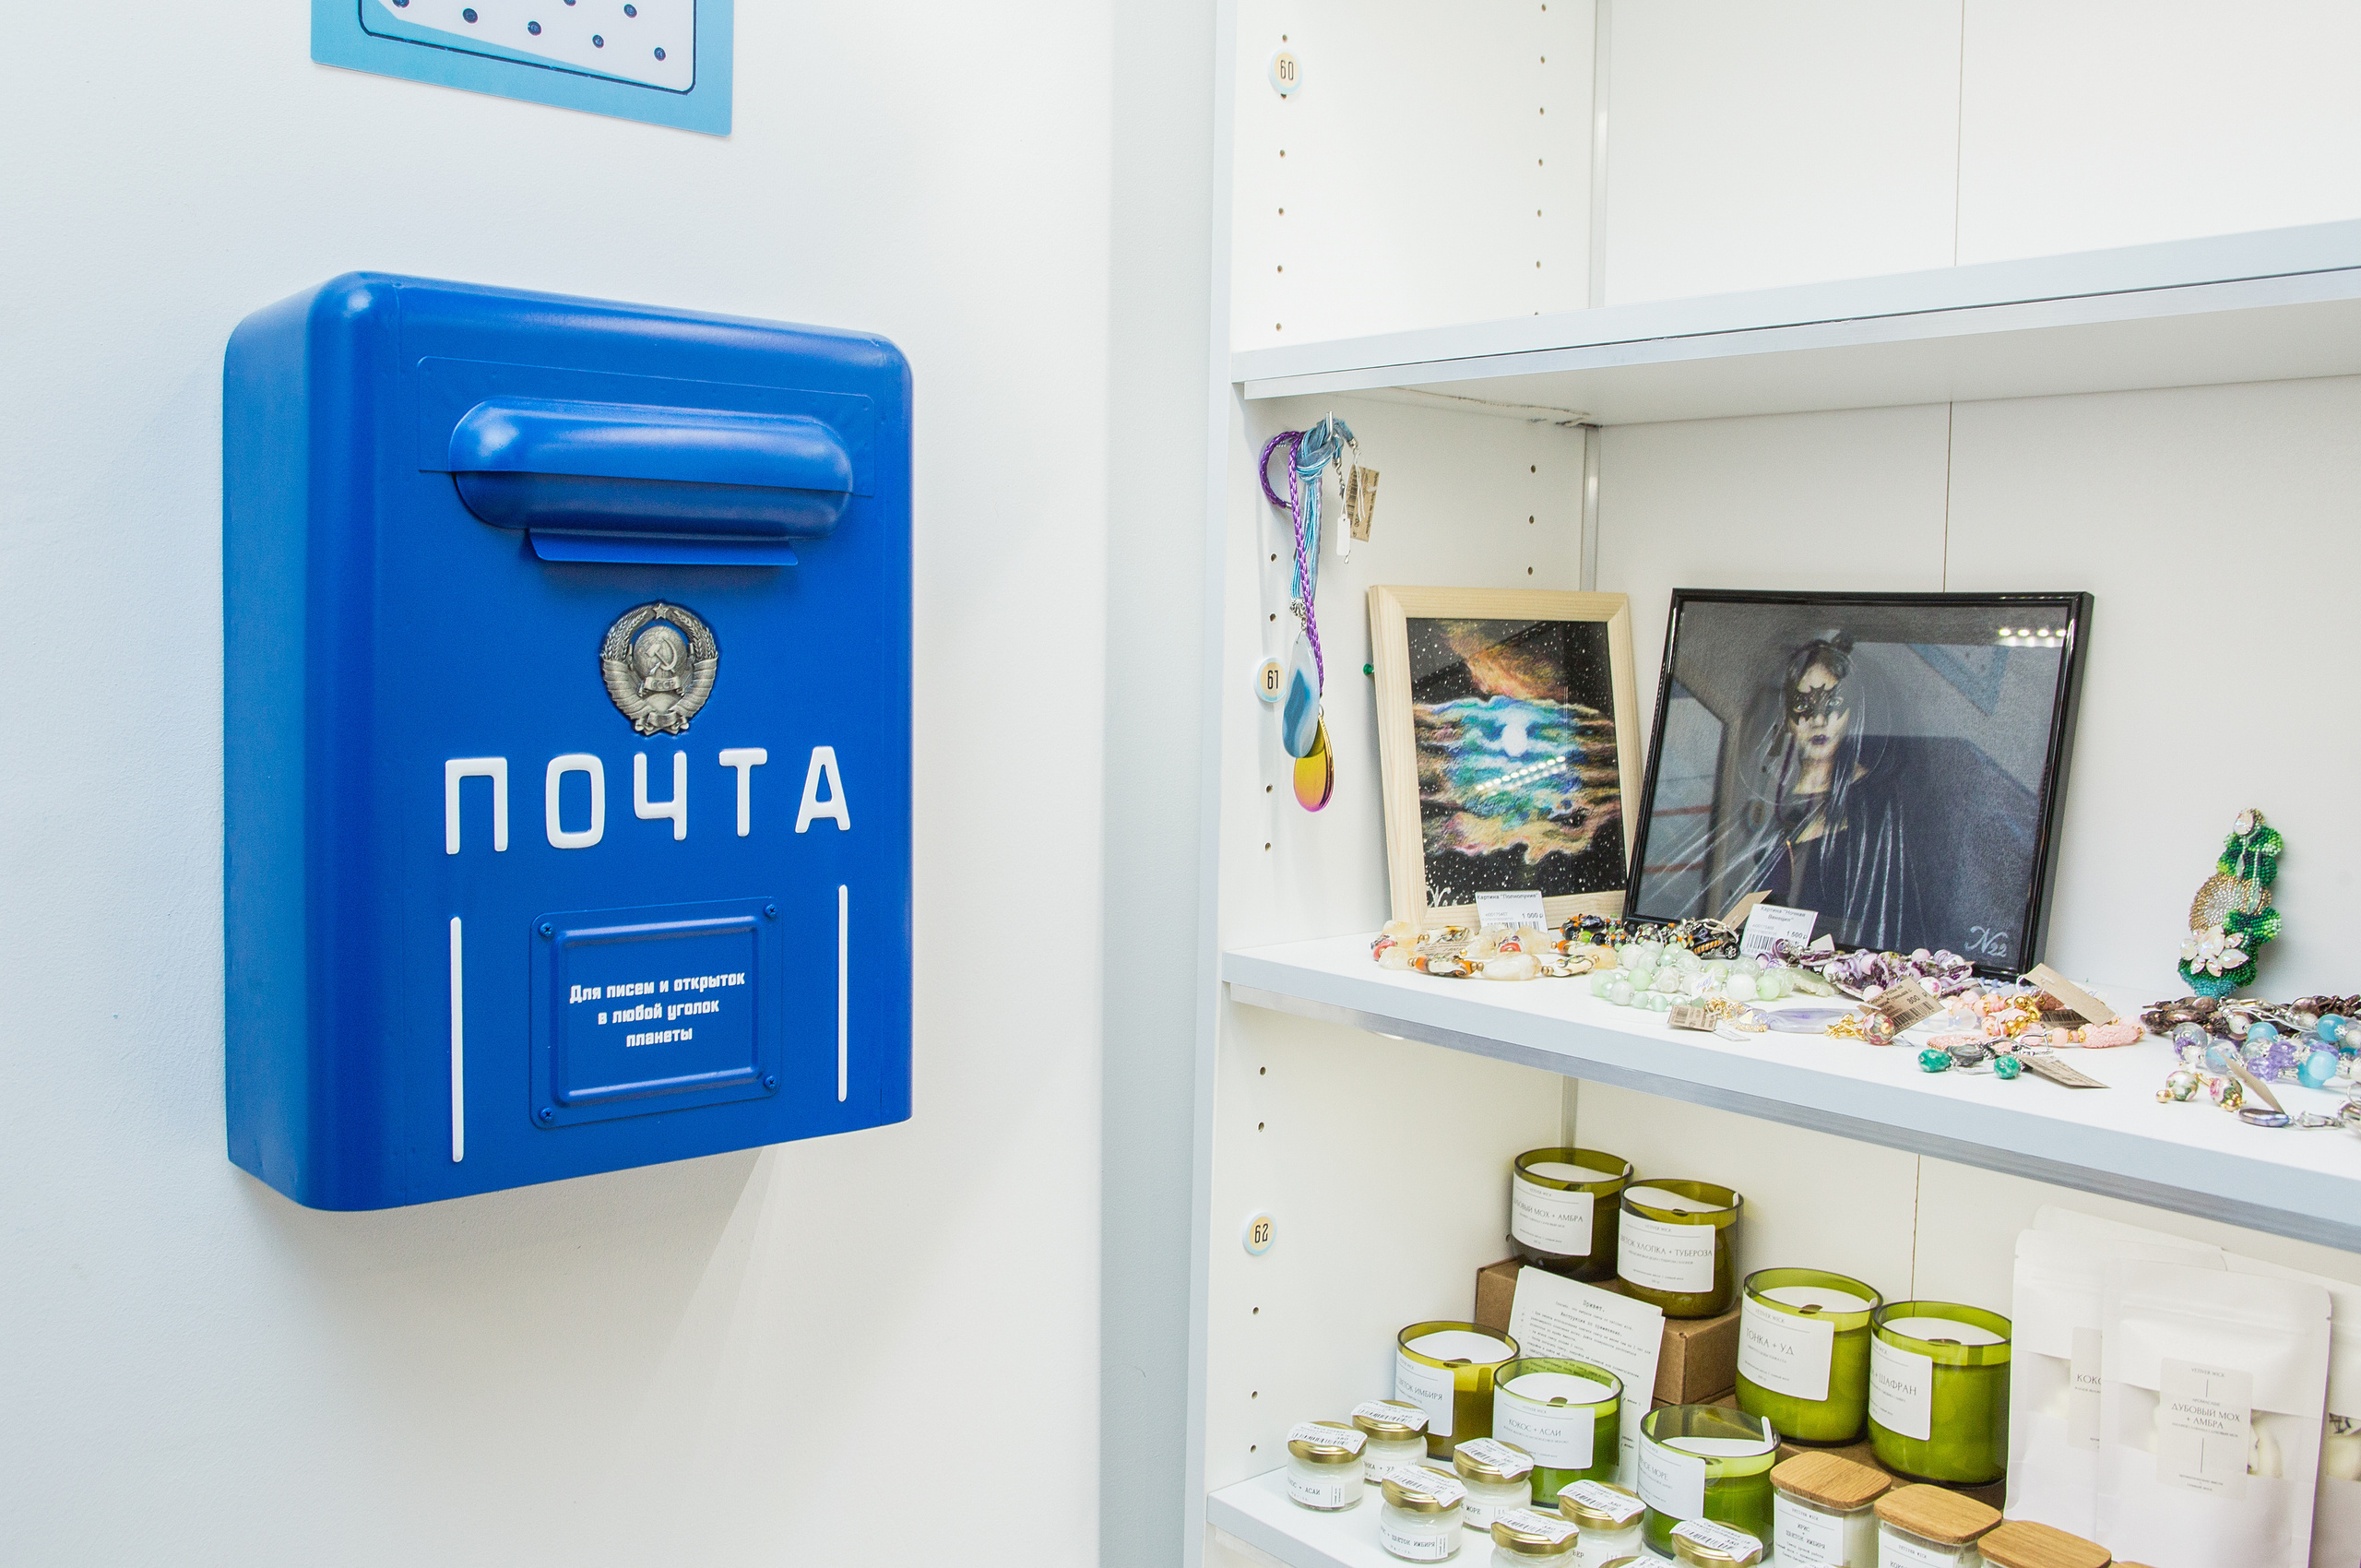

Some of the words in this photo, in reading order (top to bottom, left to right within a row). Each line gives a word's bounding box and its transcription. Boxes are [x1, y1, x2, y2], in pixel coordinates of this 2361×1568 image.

[1280, 59, 1294, 81] 60
[650, 679, 676, 690] СССР
[1267, 670, 1279, 690] 61
[445, 745, 851, 855] ПОЧТА
[569, 983, 602, 1004] Для
[606, 981, 655, 1000] писем
[659, 980, 670, 994] и
[674, 970, 746, 992] открыток
[1906, 994, 1921, 1004] 800
[598, 1010, 608, 1026] в
[612, 1003, 663, 1024] любой
[668, 999, 720, 1021] уголок
[625, 1027, 694, 1048] планеты
[1534, 1207, 1549, 1218] МОХ
[1558, 1214, 1584, 1223] АМБРА
[1254, 1223, 1269, 1243] 62
[1636, 1242, 1666, 1255] ХЛОПКА
[1675, 1249, 1713, 1257] ТУБЕРОЗА
[1746, 1327, 1770, 1348] ТОНКА
[1780, 1343, 1795, 1357] УД
[1879, 1372, 1916, 1396] ШАФРАН
[1415, 1387, 1443, 1401] ИМБИРЯ
[2171, 1403, 2216, 1418] ДУБОВЫЙ
[2218, 1411, 2240, 1422] МОХ
[1508, 1419, 1531, 1431] КОКОС
[1539, 1428, 1561, 1436] АСАИ
[2193, 1418, 2224, 1430] АМБРА
[1652, 1467, 1668, 1481] МОРЕ
[1305, 1487, 1320, 1495] АСАИ
[1466, 1506, 1481, 1515] МОРЕ
[1391, 1535, 1410, 1545] ЦВЕТОК
